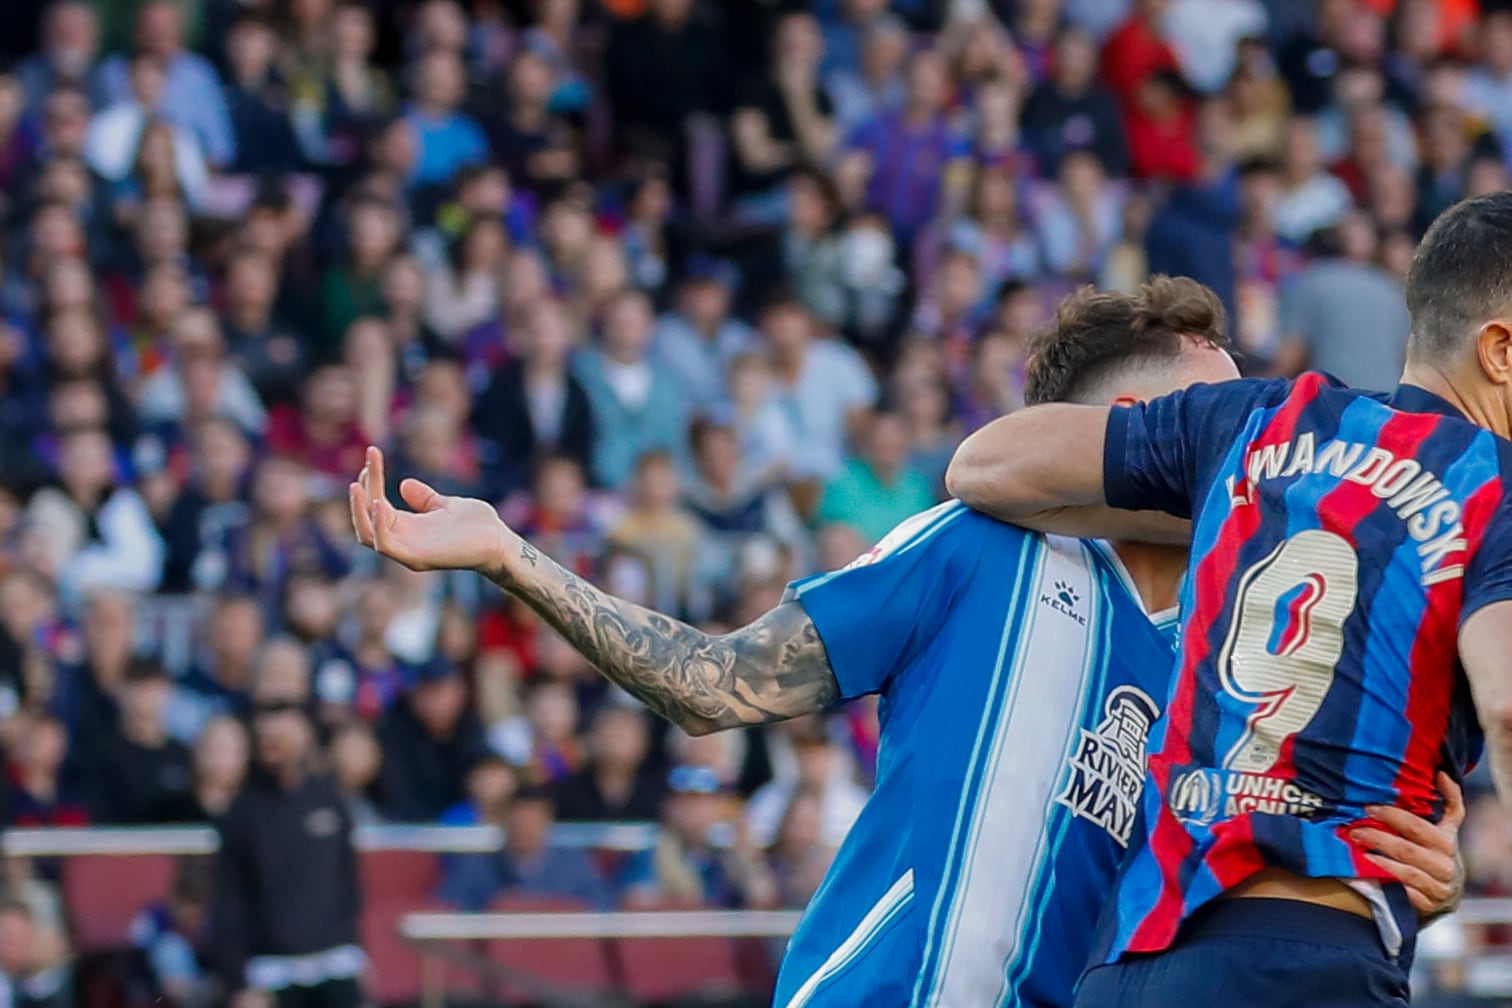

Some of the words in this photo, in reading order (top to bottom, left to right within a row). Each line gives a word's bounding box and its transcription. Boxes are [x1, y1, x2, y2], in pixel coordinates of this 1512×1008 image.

[1225, 431, 1468, 587] LWANDOWSKI
[1040, 594, 1087, 626] KELME
[1217, 528, 1360, 771] 9
[1225, 773, 1323, 807] UNHCR
